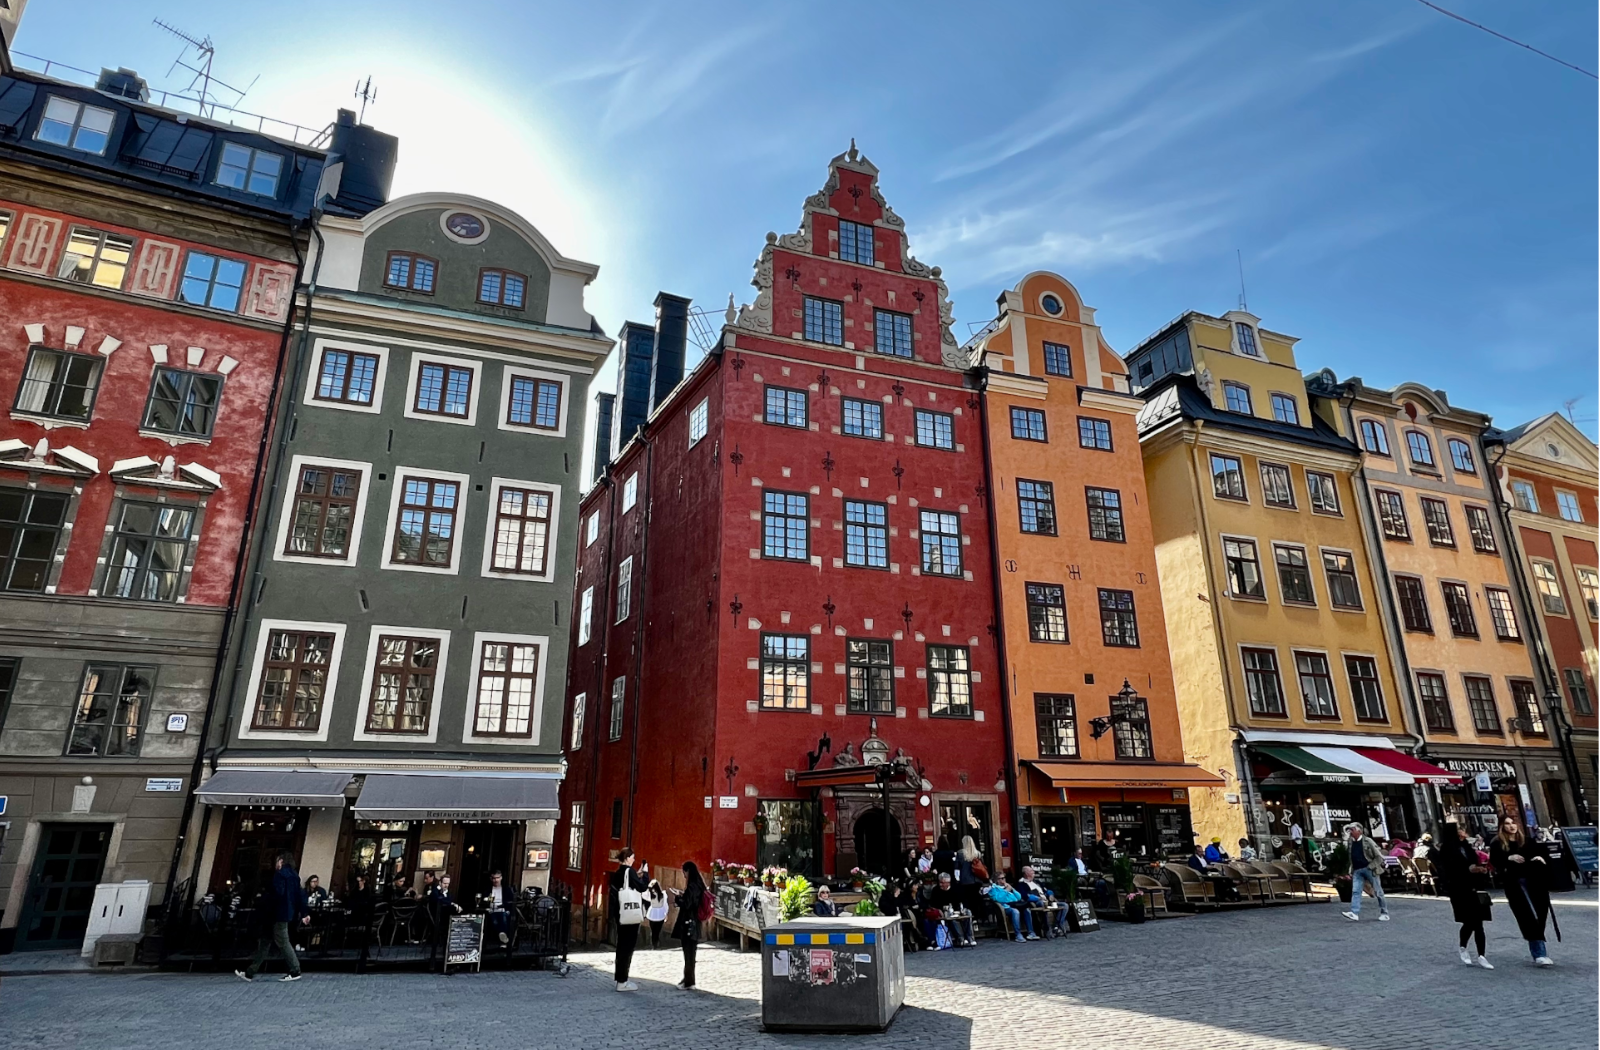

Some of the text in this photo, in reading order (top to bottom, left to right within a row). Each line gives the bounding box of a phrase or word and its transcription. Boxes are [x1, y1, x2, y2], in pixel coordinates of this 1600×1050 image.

[1449, 760, 1503, 772] RUNSTENEN
[426, 811, 469, 819] Restaurang
[1310, 809, 1351, 817] TRATORIA
